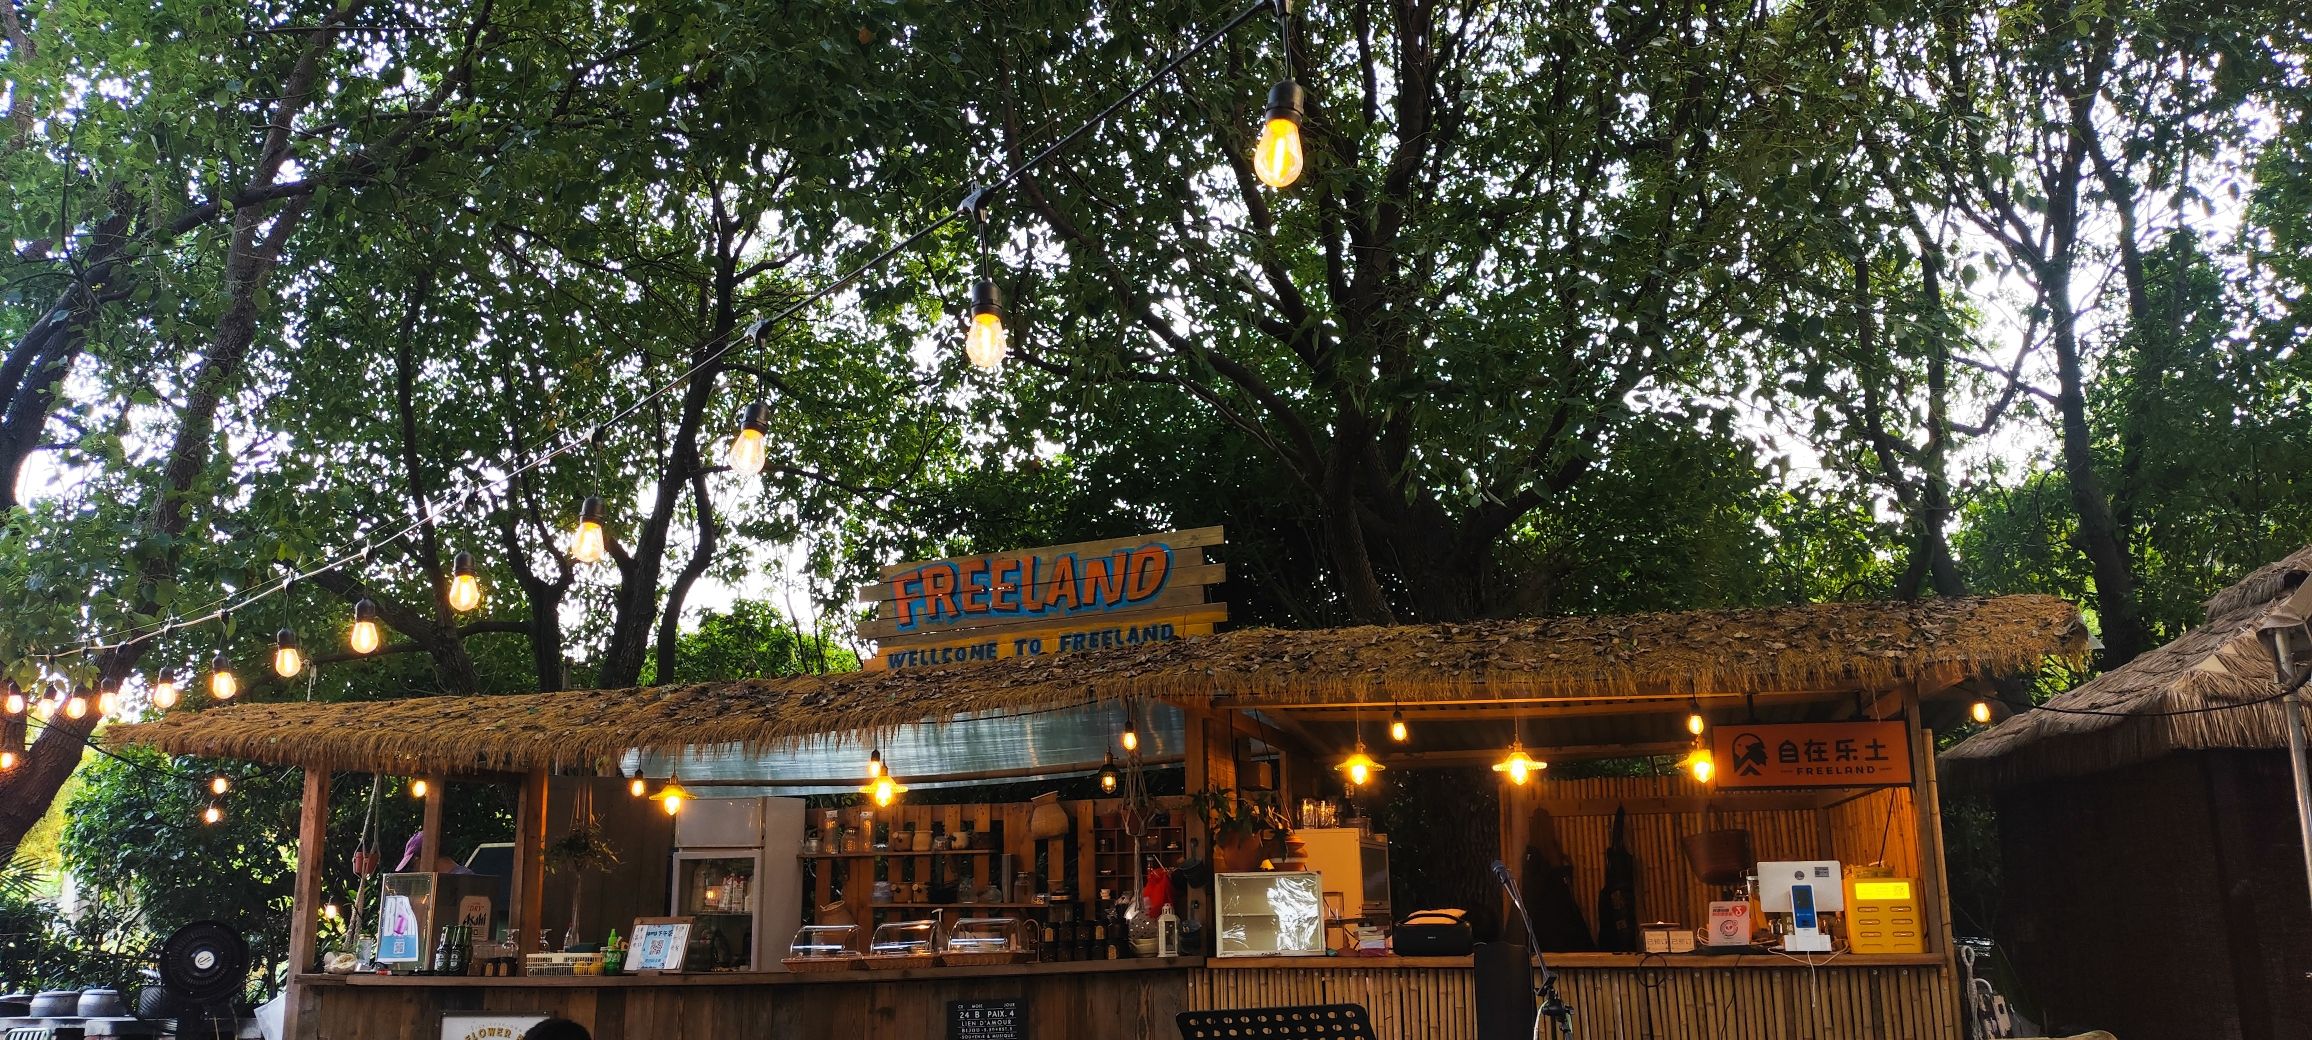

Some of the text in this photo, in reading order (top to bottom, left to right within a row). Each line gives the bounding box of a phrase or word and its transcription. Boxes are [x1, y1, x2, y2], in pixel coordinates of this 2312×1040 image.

[892, 545, 1172, 630] FREELAND
[888, 624, 1175, 668] WELLCOME TO FREELAND
[1778, 738, 1889, 762] 自在乐土
[1796, 766, 1876, 776] FREELAND
[960, 1011, 970, 1019] 24
